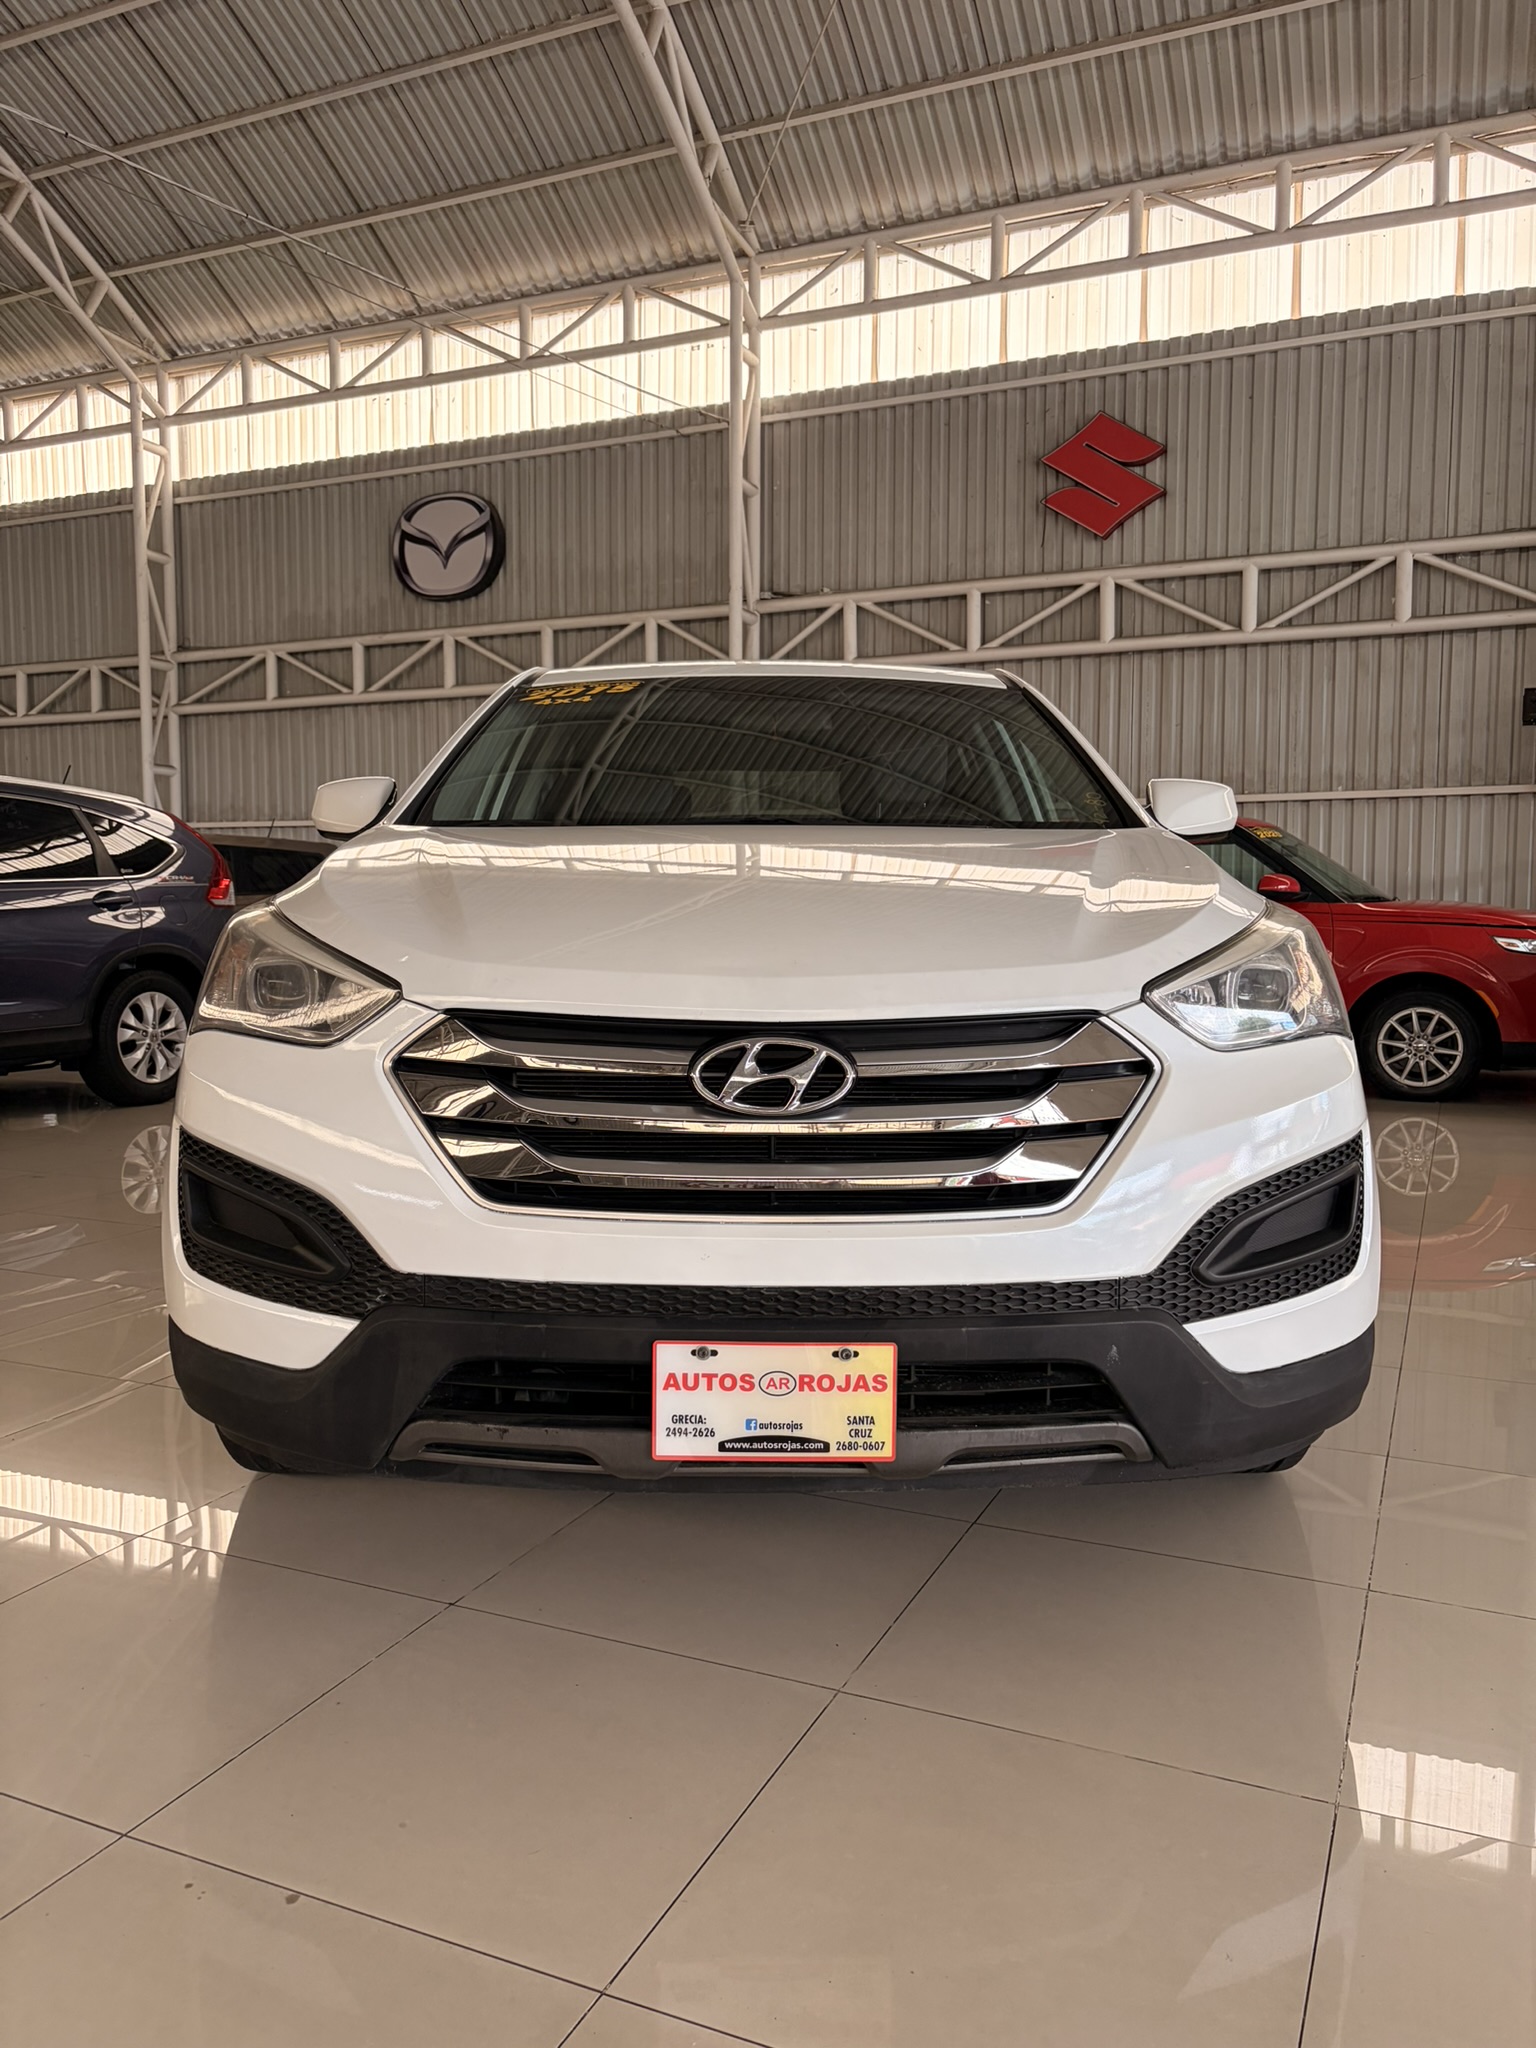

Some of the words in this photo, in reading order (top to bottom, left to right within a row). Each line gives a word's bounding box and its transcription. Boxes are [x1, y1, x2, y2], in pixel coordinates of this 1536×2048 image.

[662, 1372, 756, 1392] AUTOS
[765, 1377, 791, 1390] AR
[797, 1373, 888, 1393] ROJAS
[671, 1414, 707, 1425] GRECIA:
[846, 1415, 876, 1426] SANTA
[758, 1420, 804, 1433] autosrojas
[665, 1427, 716, 1438] 2494-2626
[848, 1428, 873, 1439] CRUZ
[724, 1440, 824, 1452] www.autosrojas.com
[835, 1441, 886, 1452] 2680-0607
